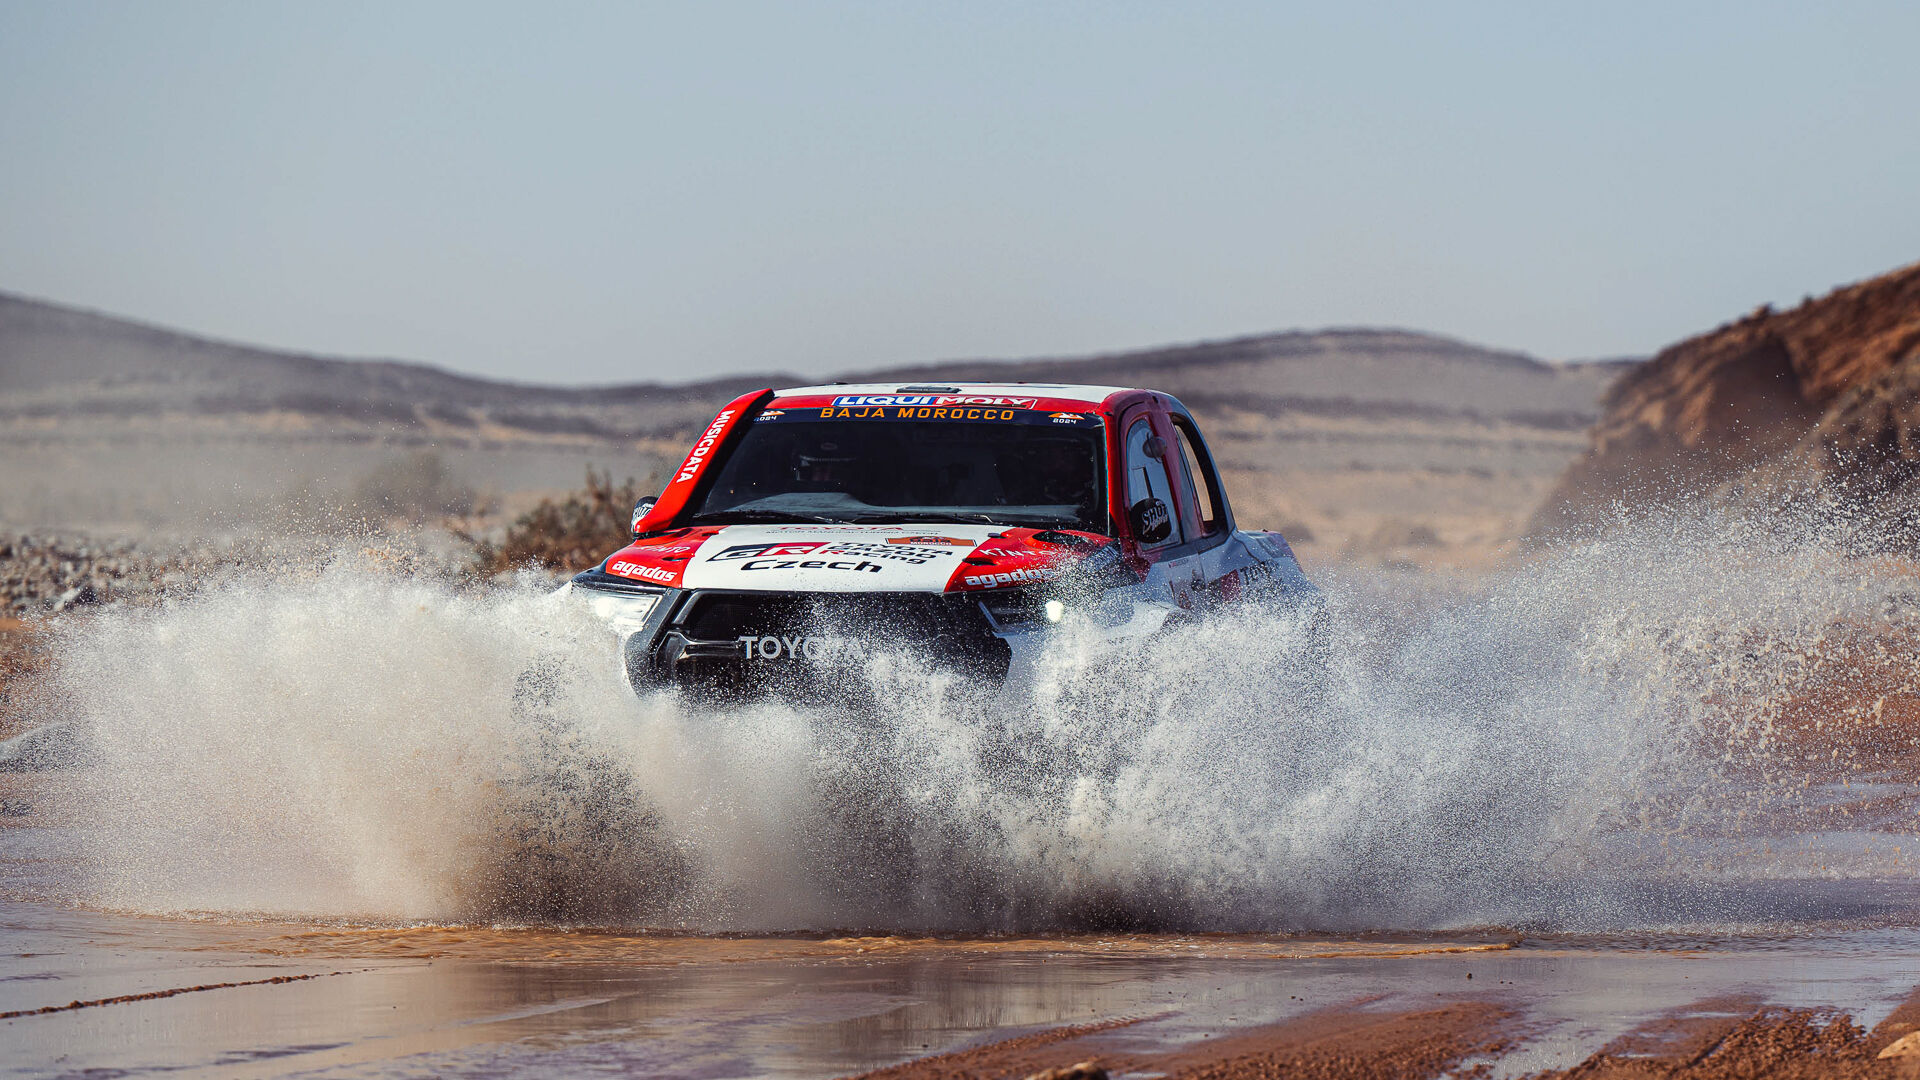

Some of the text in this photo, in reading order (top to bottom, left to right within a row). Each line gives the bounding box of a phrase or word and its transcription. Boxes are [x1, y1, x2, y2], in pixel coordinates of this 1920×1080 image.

[838, 396, 1032, 406] LIQUI MOLY
[819, 407, 1014, 421] BAJA MOROCCO
[676, 409, 736, 484] MUSICDATA
[708, 544, 821, 561] GR
[827, 546, 937, 559] GAZOO
[839, 542, 953, 556] TOYOTA
[819, 550, 927, 564] Racing
[612, 561, 677, 582] agados
[740, 559, 883, 573] Czech
